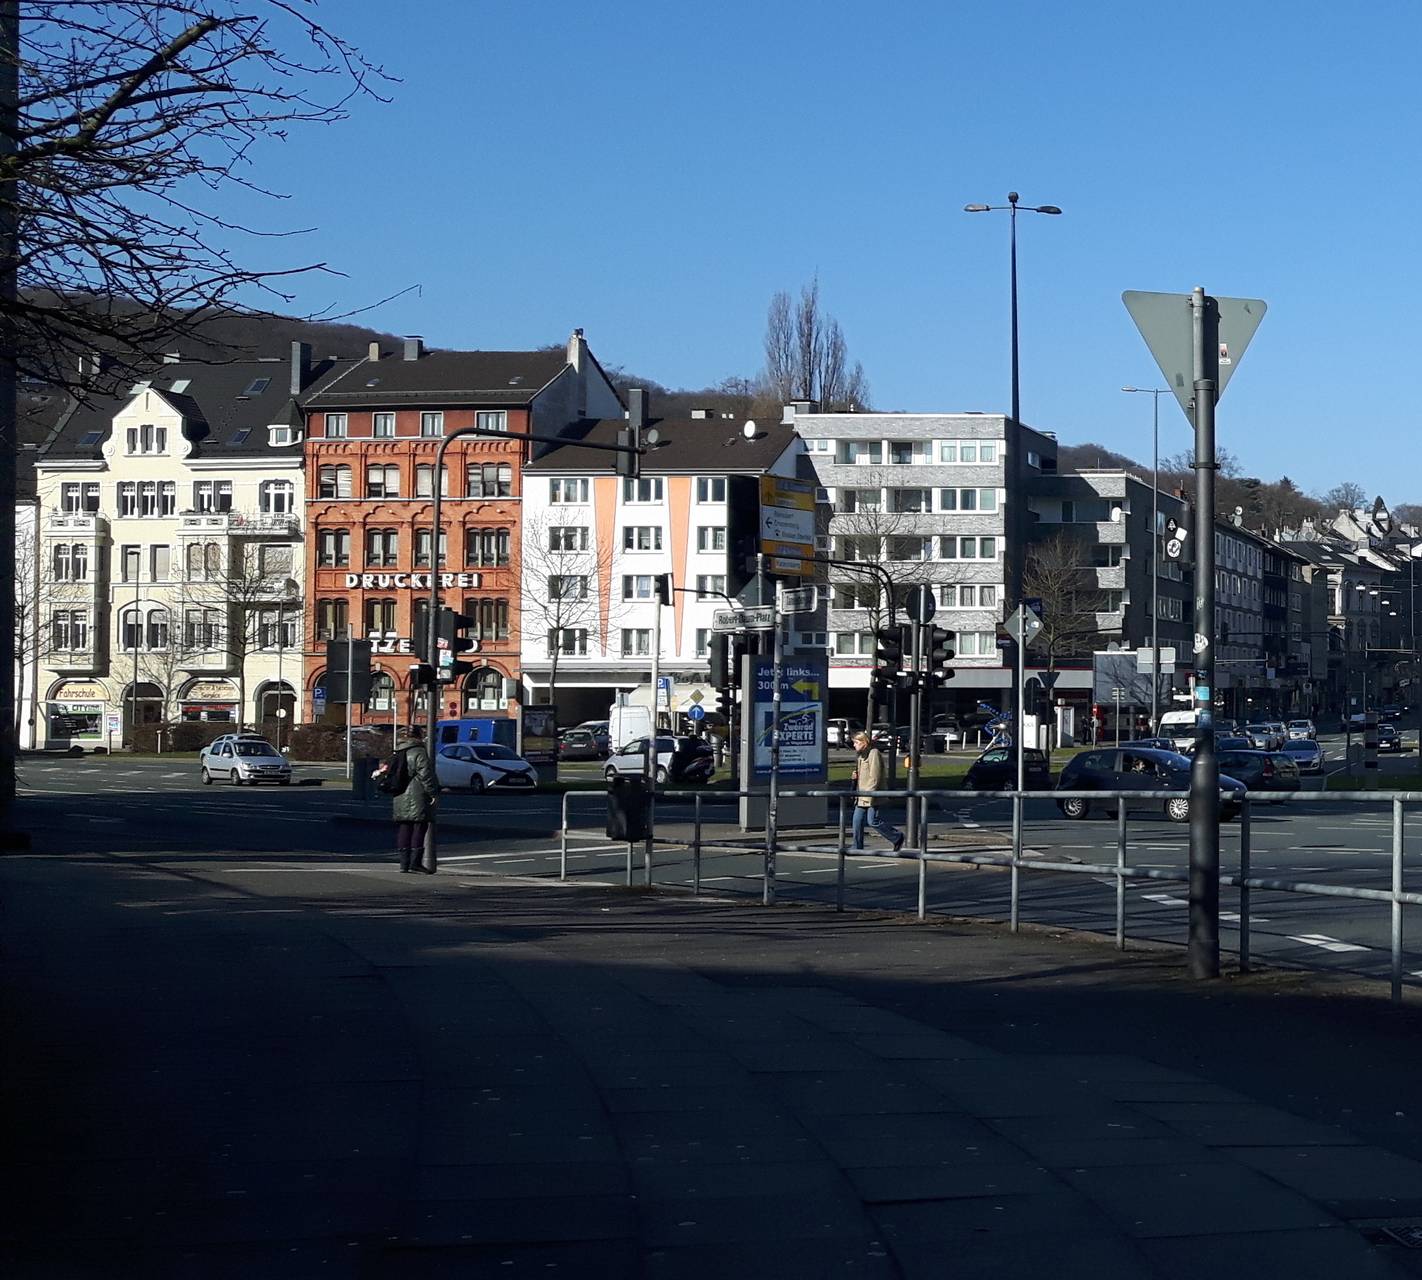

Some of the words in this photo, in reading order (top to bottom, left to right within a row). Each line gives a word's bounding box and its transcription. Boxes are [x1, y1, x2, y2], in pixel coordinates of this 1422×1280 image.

[59, 687, 96, 698] Fahrschule
[783, 723, 814, 731] Zweirad
[779, 731, 814, 741] XPERTE
